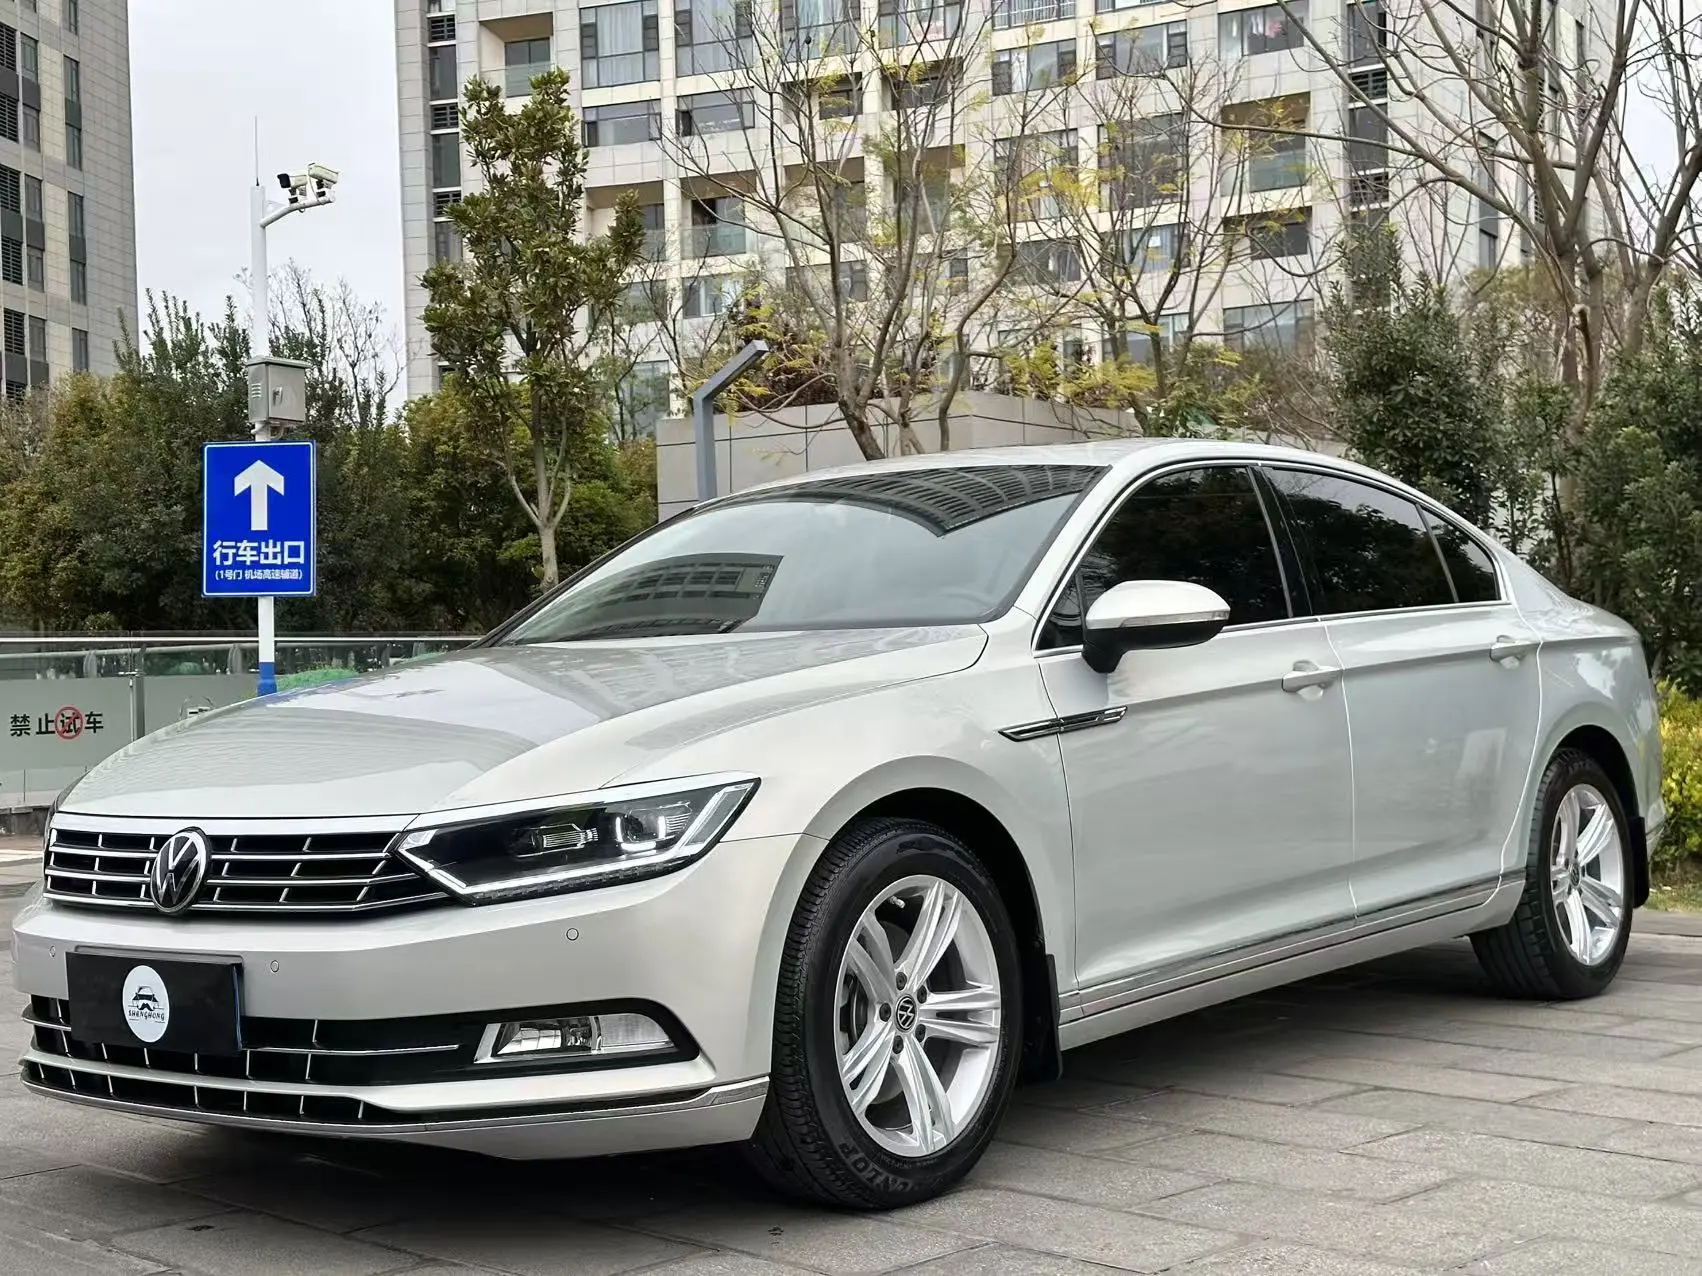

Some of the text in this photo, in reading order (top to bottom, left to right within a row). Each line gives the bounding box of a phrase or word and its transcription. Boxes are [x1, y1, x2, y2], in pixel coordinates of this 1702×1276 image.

[213, 539, 305, 566] 行车出口
[215, 569, 243, 580] (1号门
[10, 711, 104, 737] 禁止试车
